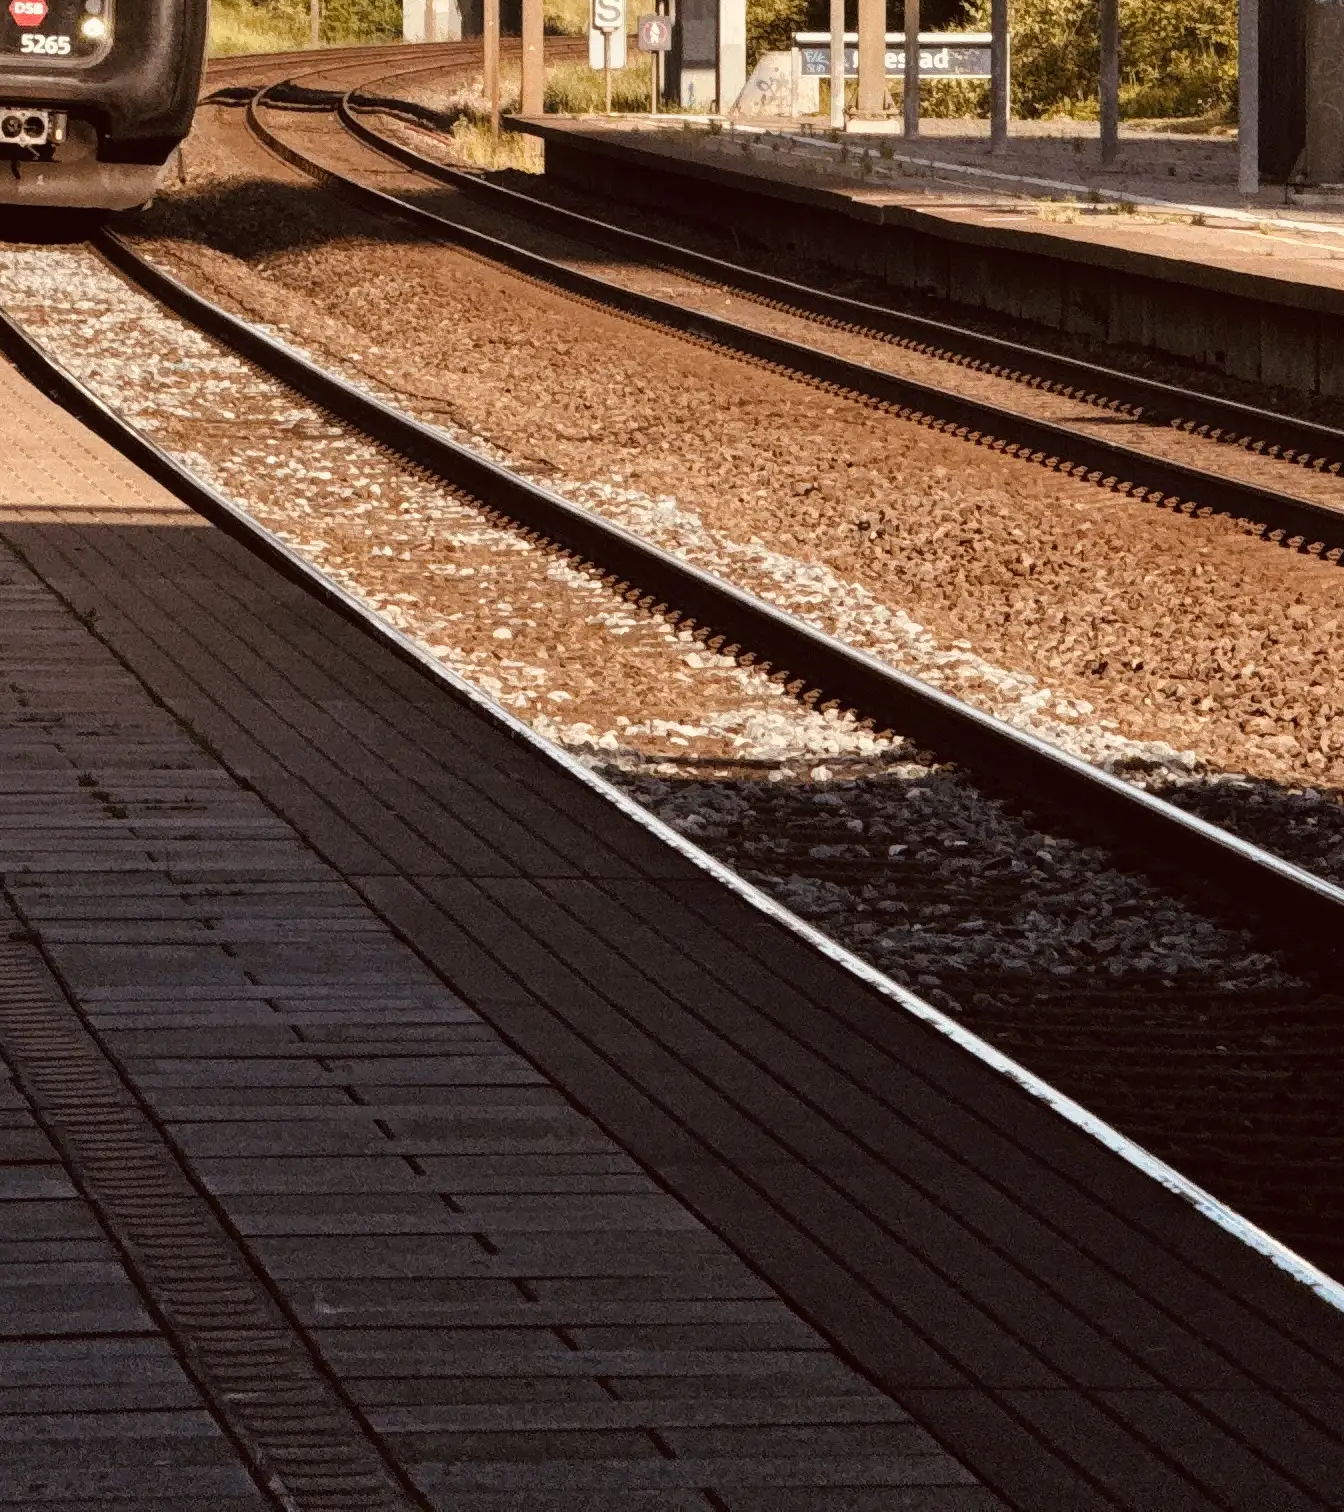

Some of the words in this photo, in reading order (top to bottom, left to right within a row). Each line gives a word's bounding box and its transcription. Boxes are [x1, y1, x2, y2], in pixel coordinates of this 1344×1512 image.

[14, 1, 44, 15] DSB
[20, 33, 71, 55] 5265
[853, 47, 949, 70] esad
